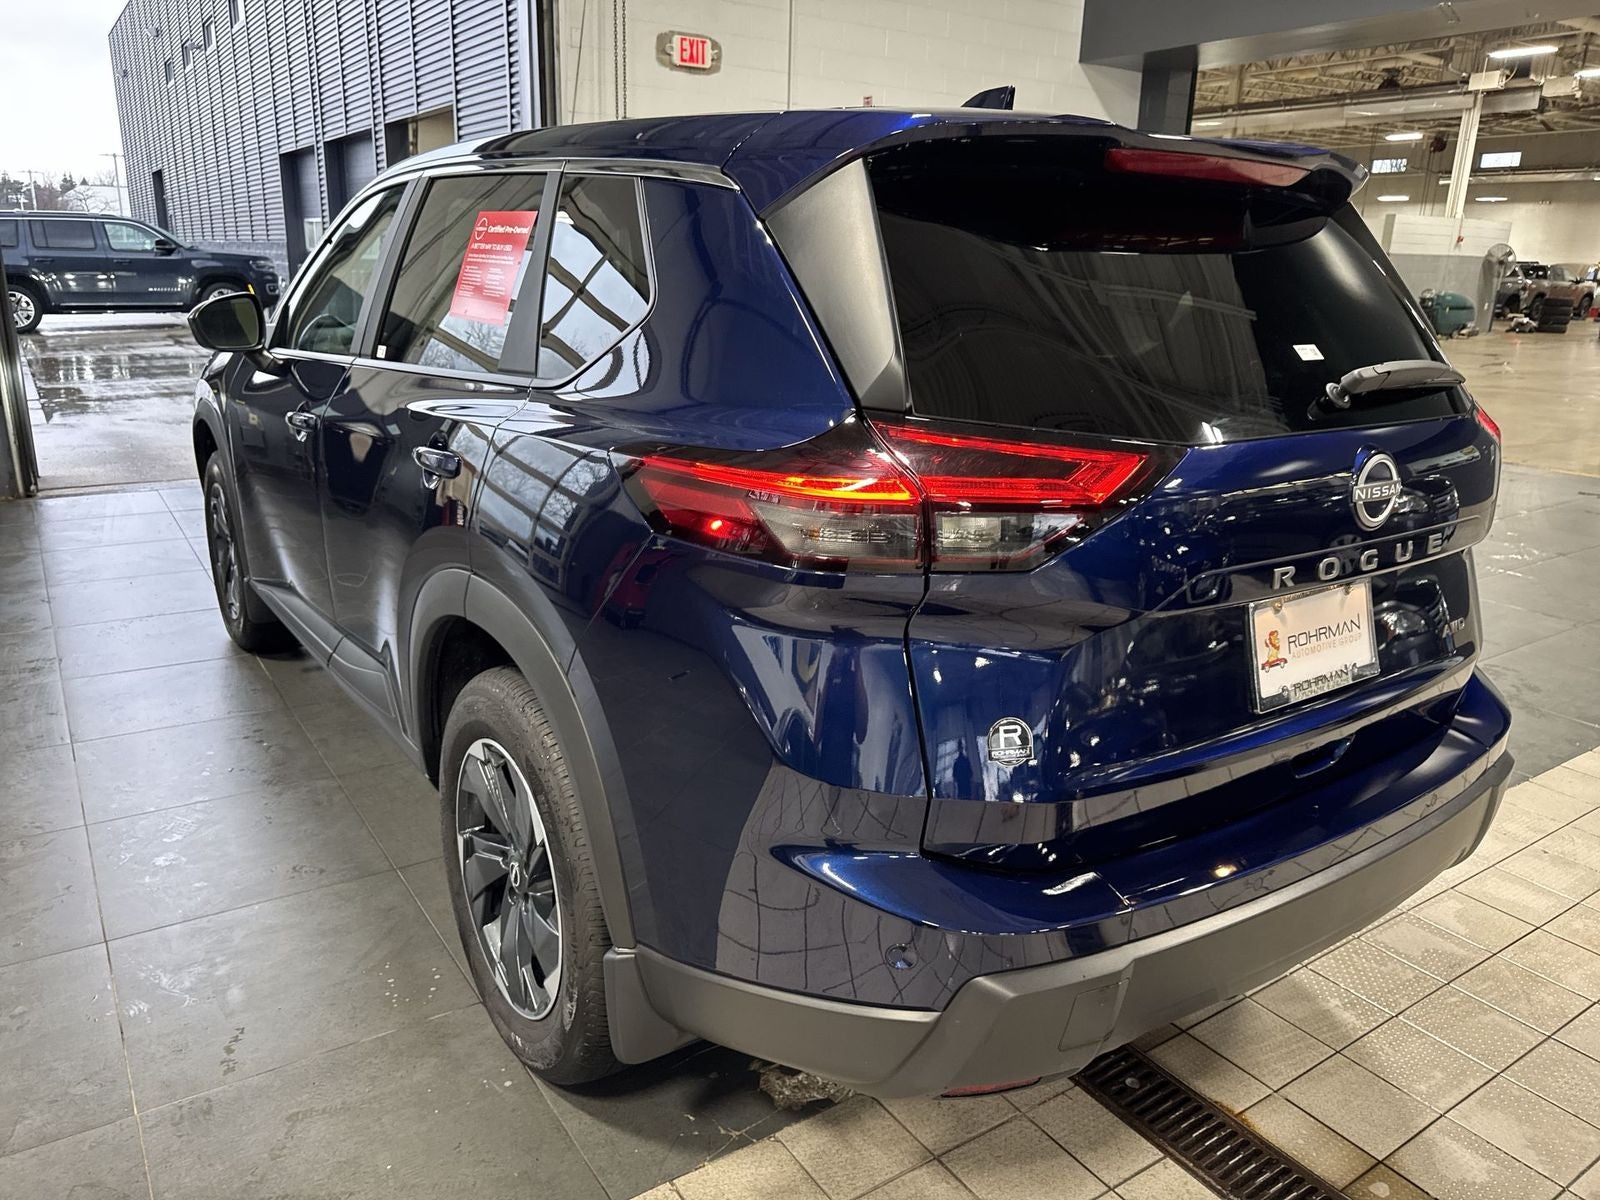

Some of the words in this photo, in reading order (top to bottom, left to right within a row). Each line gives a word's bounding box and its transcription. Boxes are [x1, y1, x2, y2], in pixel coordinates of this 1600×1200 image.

[680, 37, 707, 65] EXIT
[487, 225, 506, 233] Certified
[506, 226, 530, 234] Pre-Owned
[1355, 482, 1402, 500] NISSAN
[1272, 534, 1443, 589] ROGUE
[1288, 613, 1361, 654] ROHRMAN
[1292, 641, 1337, 658] AUTOMOTIVE
[1338, 634, 1362, 648] GROUP
[1293, 664, 1349, 695] ROHRMAN
[999, 724, 1022, 748] R
